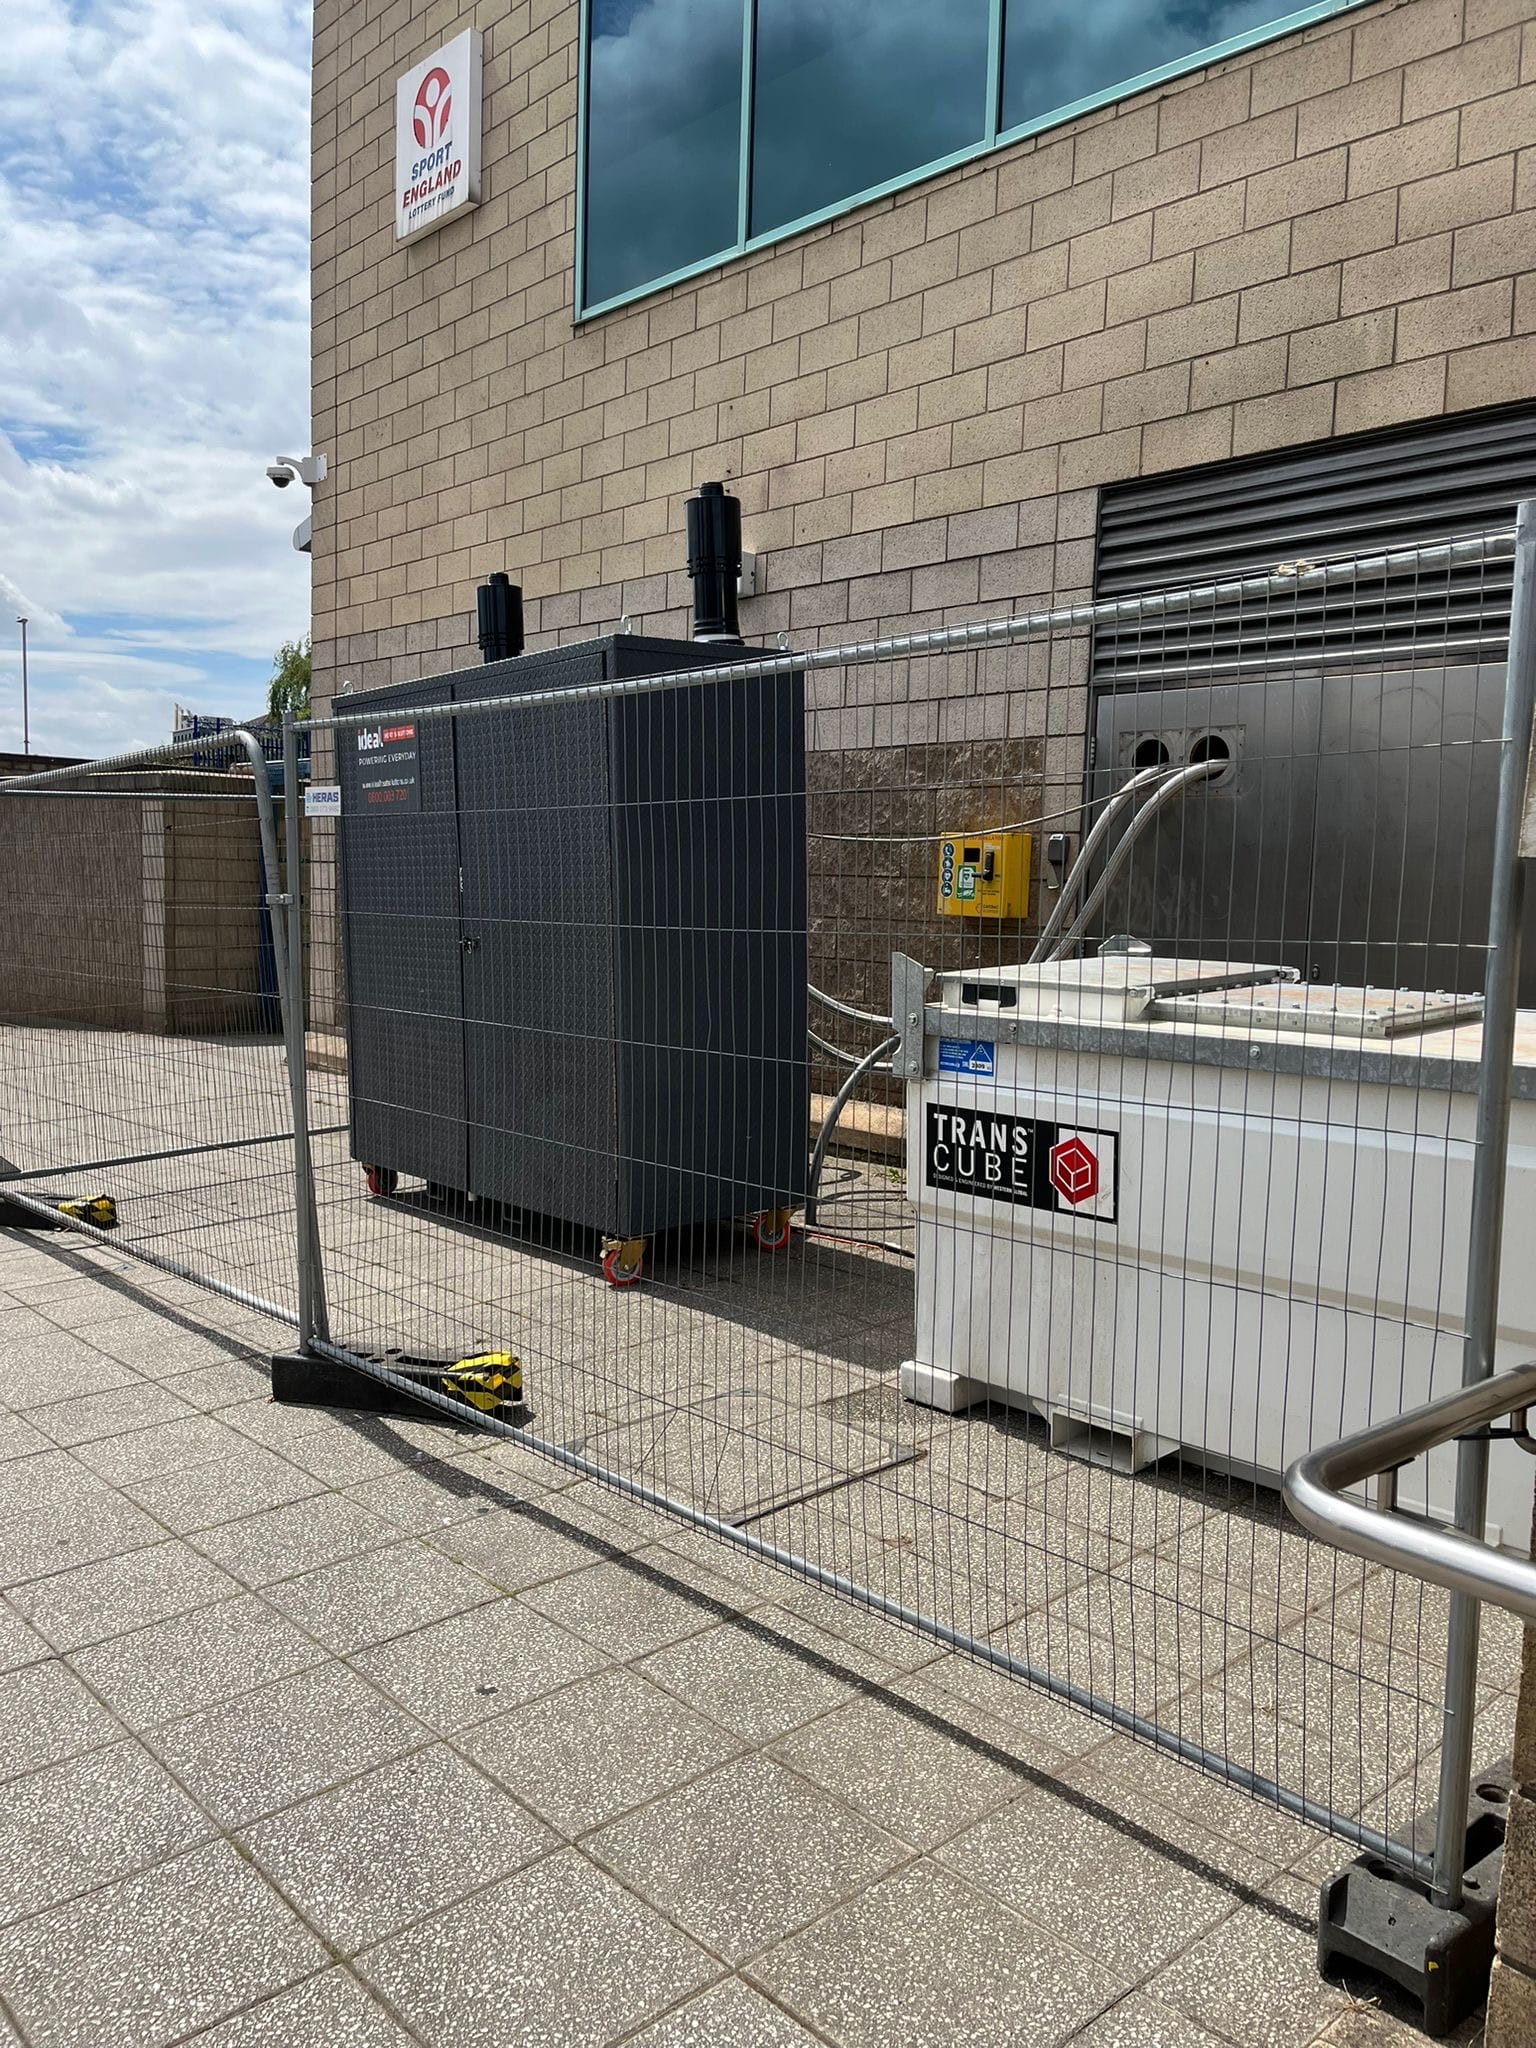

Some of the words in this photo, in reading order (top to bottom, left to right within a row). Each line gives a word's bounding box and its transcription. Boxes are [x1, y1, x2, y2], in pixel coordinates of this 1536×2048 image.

[411, 140, 453, 181] SPORT
[402, 159, 462, 209] ENGLAND
[408, 196, 437, 220] LOTTERY
[437, 185, 455, 204] FUND
[358, 755, 388, 767] POWERING
[388, 751, 417, 763] EVERYDAY
[311, 792, 339, 803] HERAS
[933, 1113, 1028, 1156] TRANS
[933, 1144, 1028, 1188] CUBE
